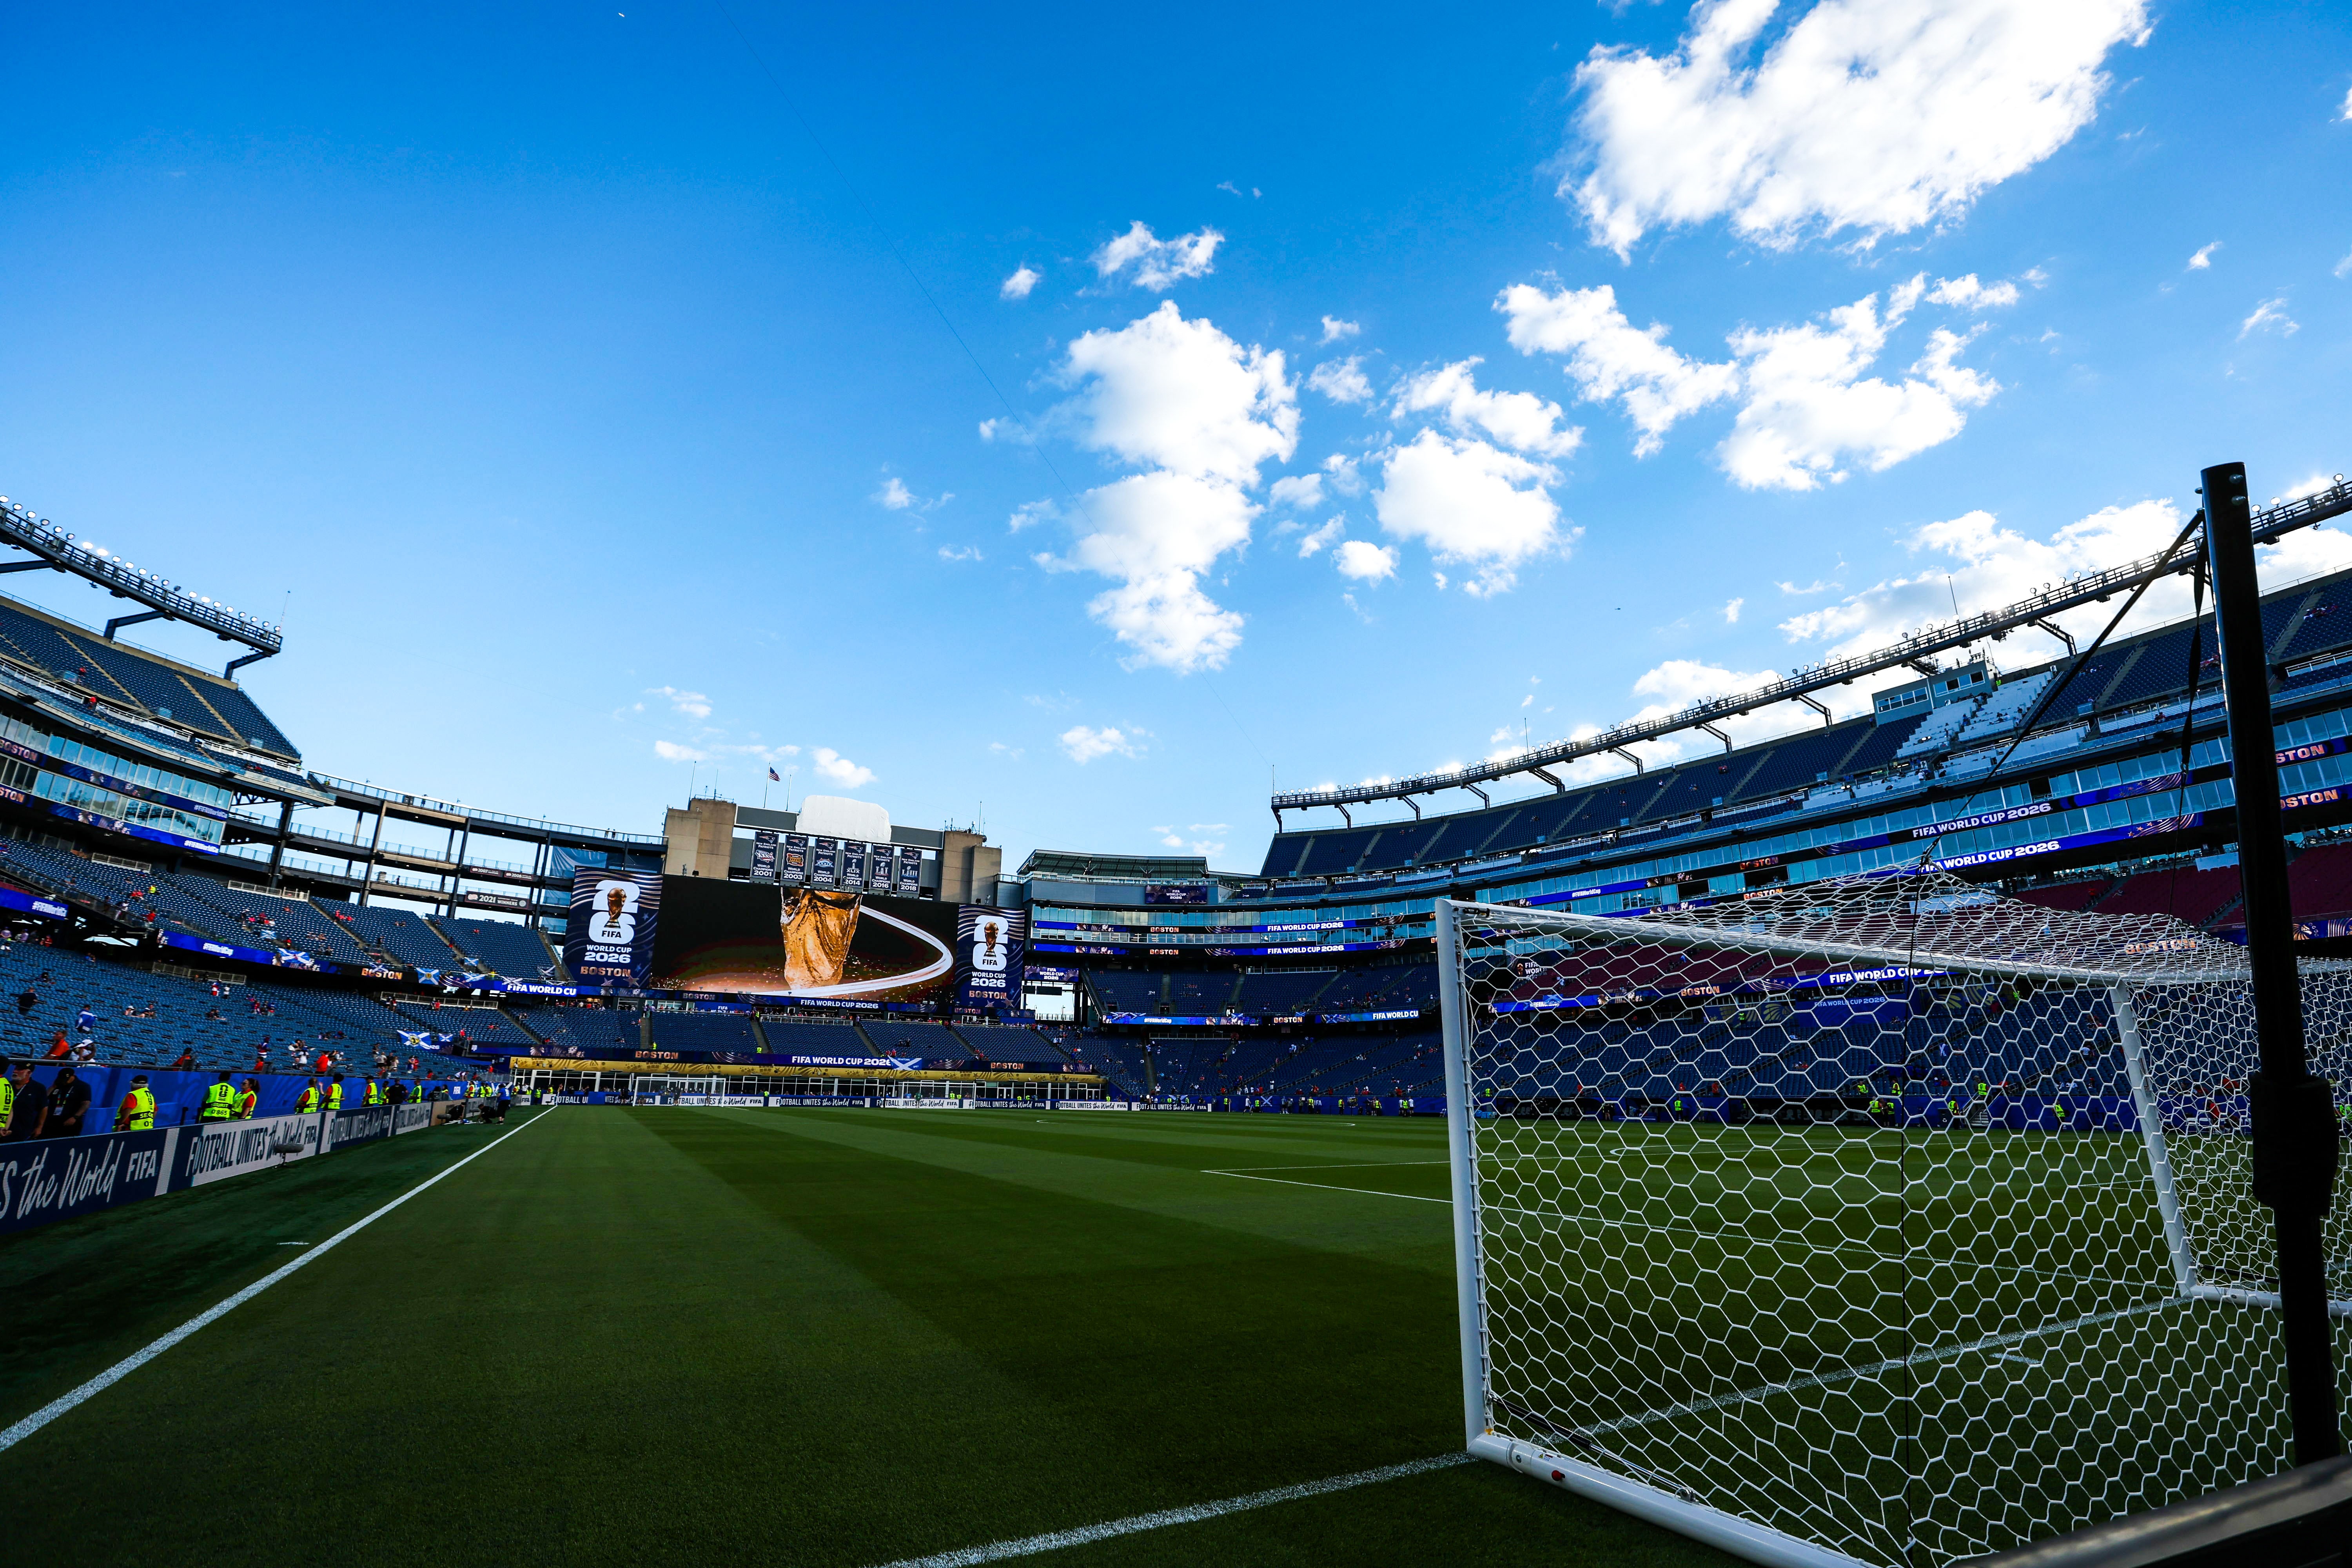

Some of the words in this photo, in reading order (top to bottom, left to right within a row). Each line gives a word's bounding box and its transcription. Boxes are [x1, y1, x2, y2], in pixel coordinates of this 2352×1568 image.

[1913, 827, 1937, 838] FIFA
[1937, 818, 1980, 833] WORLD
[1981, 812, 2005, 824] CUP
[2007, 803, 2051, 819] 2026
[1944, 854, 1987, 868] WORLD
[1988, 849, 2013, 861] CUP
[2014, 840, 2060, 857] 2026
[1572, 889, 1601, 897] #FIFAWorldCup
[1744, 888, 1783, 900] BOSTON
[479, 895, 496, 903] 2021
[584, 952, 631, 963] 2026
[361, 968, 403, 980] BOSTON
[580, 966, 631, 977] BOSTON
[1829, 975, 1853, 983] FIFA
[1854, 969, 1896, 981] WORLD
[971, 978, 1006, 987] 2026
[529, 985, 563, 995] WORLD
[969, 991, 1007, 999] BOSTON
[1681, 986, 1720, 996] BOSTON
[727, 1097, 747, 1105] World
[822, 1098, 831, 1106] the
[832, 1098, 850, 1107] World
[185, 1131, 236, 1176] FOOTBALL
[236, 1127, 268, 1165] UNITES
[17, 1147, 58, 1220] the
[58, 1139, 125, 1209] World
[125, 1149, 158, 1182] FIFA
